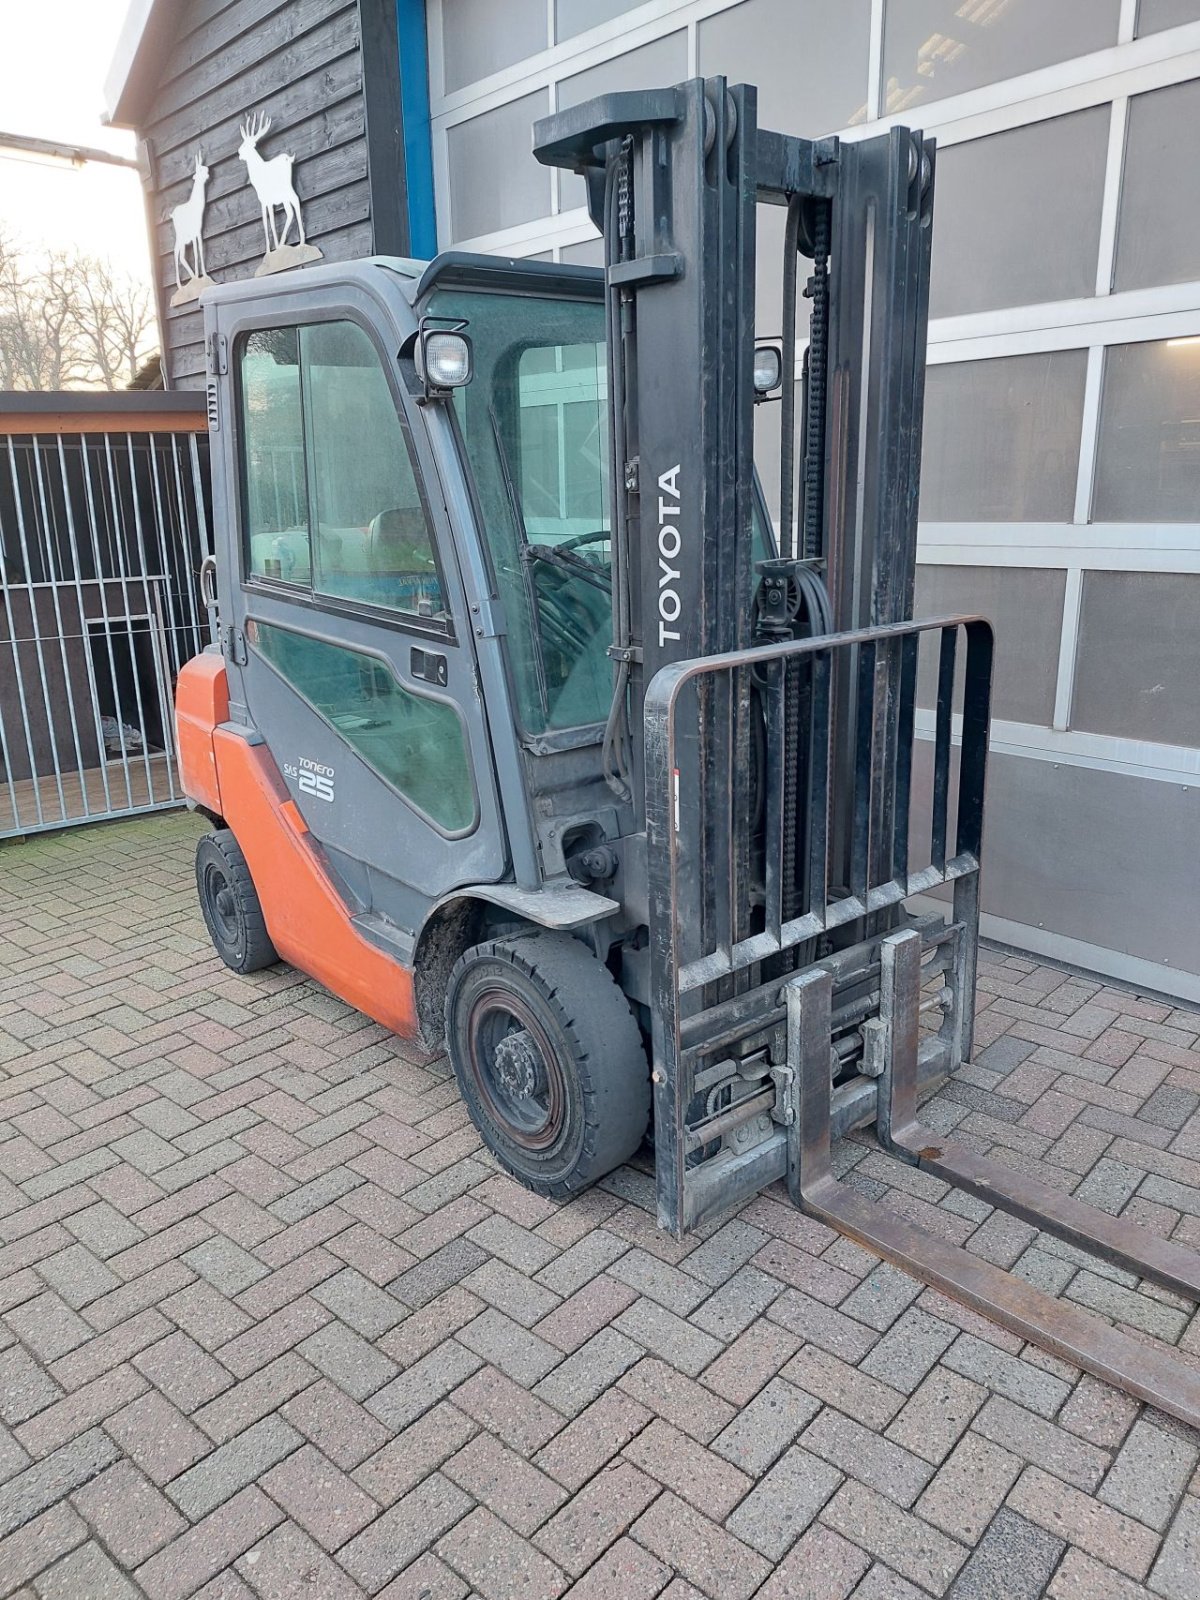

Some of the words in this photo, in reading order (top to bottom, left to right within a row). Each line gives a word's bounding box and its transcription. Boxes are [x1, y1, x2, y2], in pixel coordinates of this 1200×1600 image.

[658, 463, 682, 647] TOYOTA
[283, 763, 298, 777] SAS
[298, 769, 335, 803] 25
